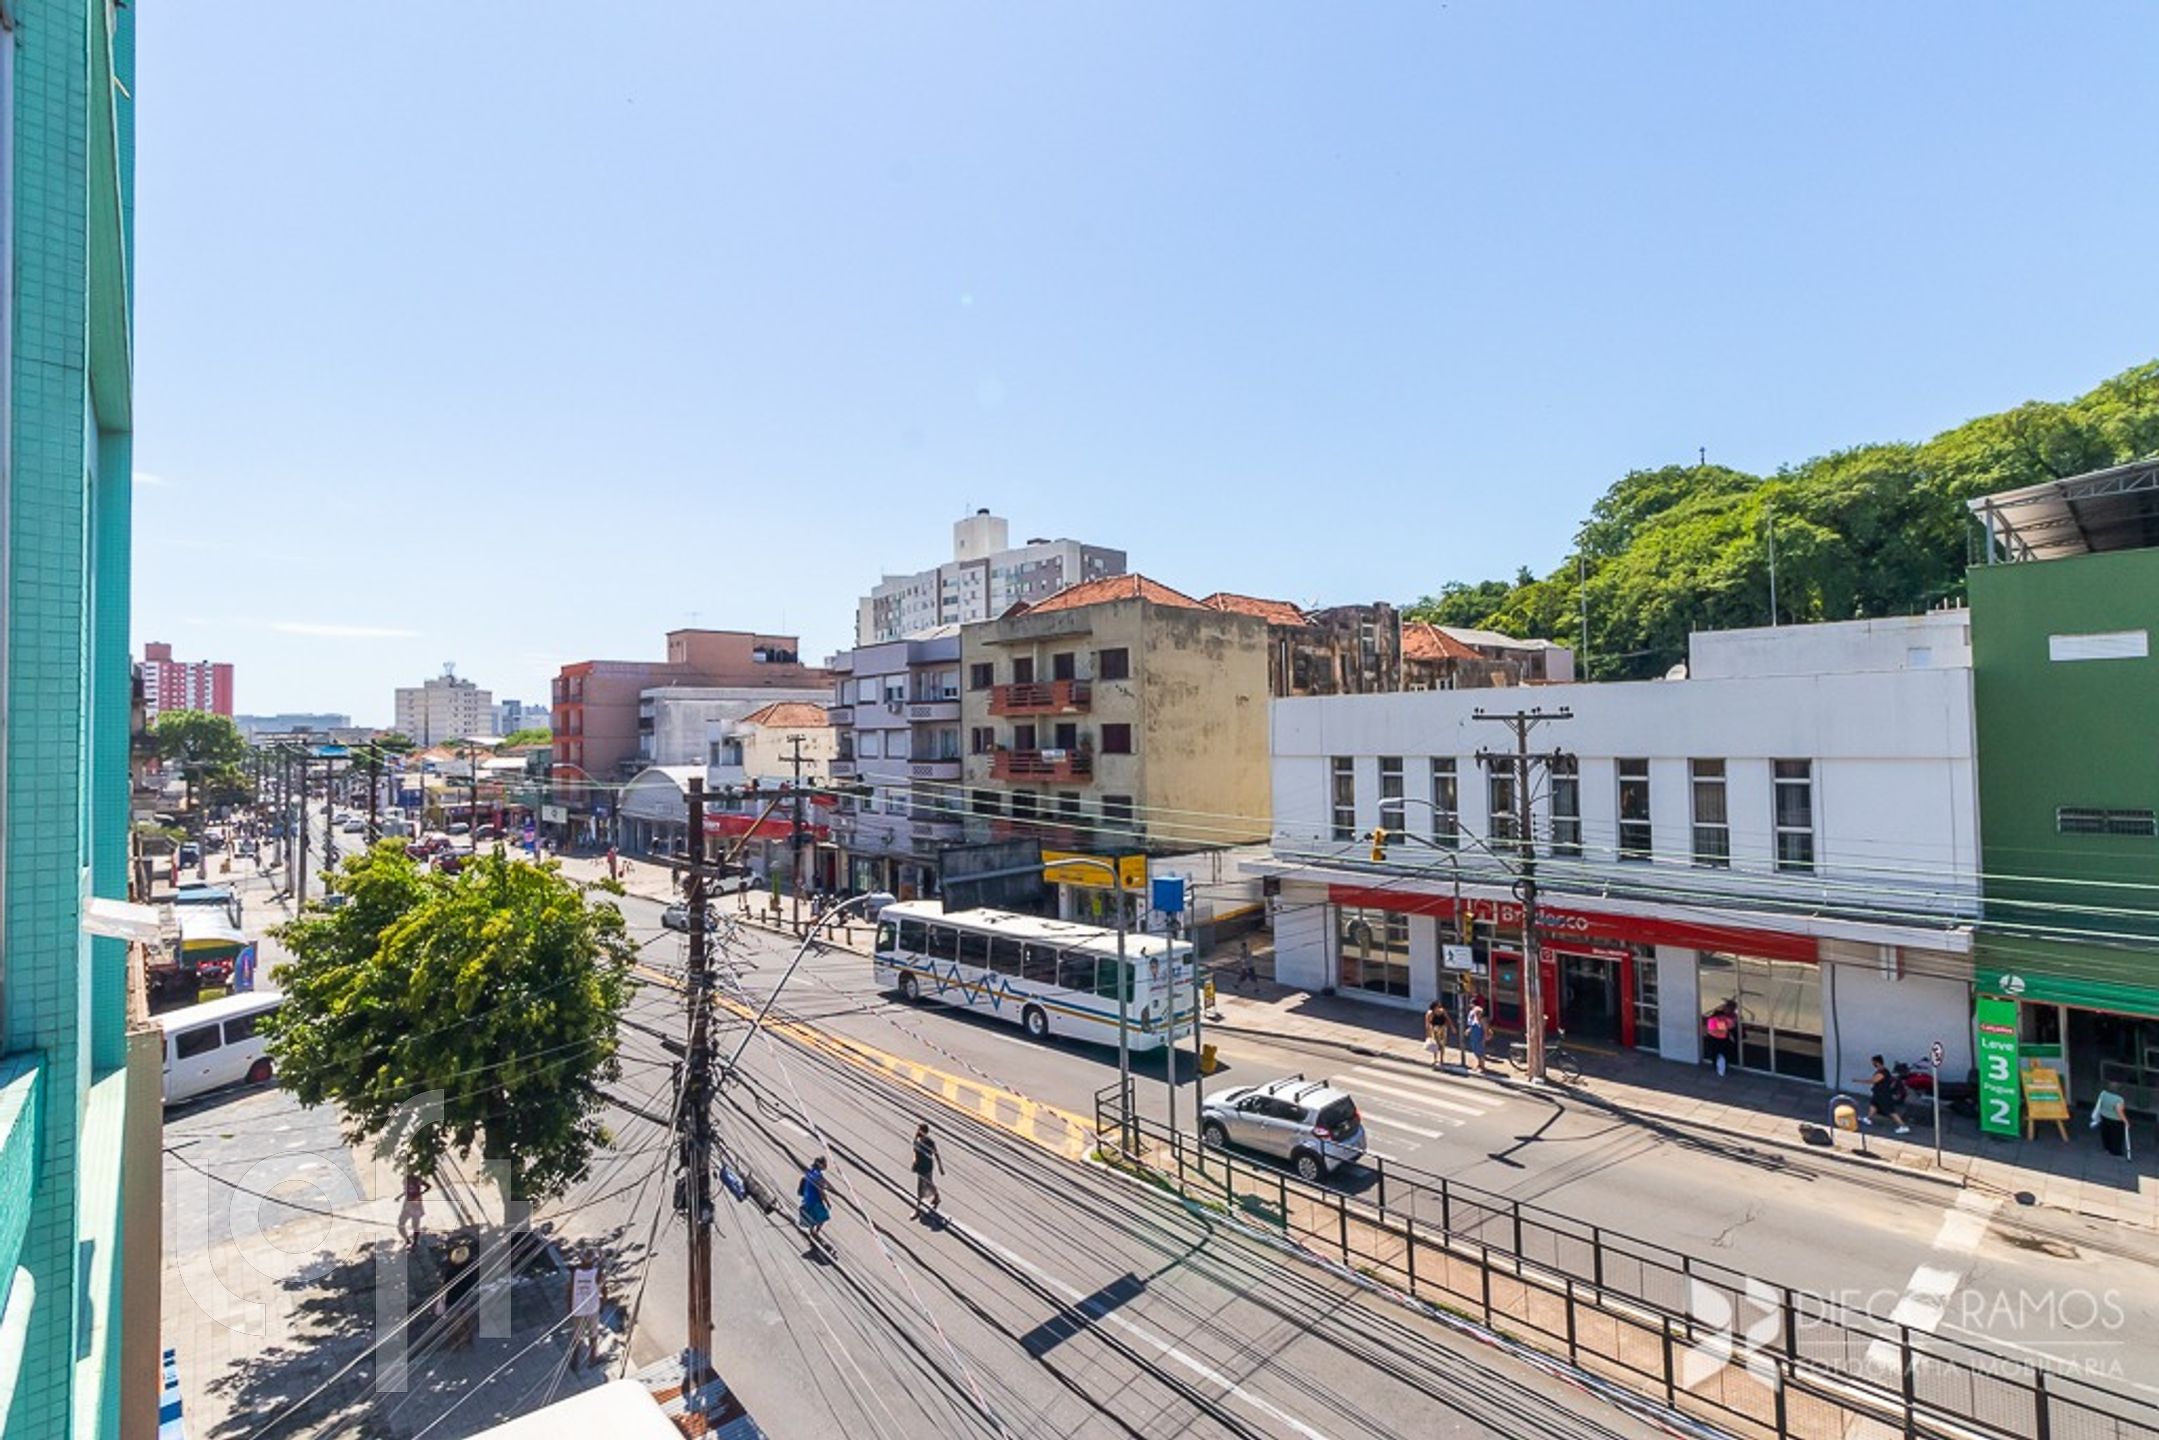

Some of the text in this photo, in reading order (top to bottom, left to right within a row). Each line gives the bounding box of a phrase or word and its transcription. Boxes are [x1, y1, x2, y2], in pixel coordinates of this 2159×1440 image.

[1502, 905, 1588, 930] Brdesco
[1981, 1037, 2014, 1052] Leve
[1988, 1055, 2009, 1081] 3
[1989, 1099, 2010, 1125] 2
